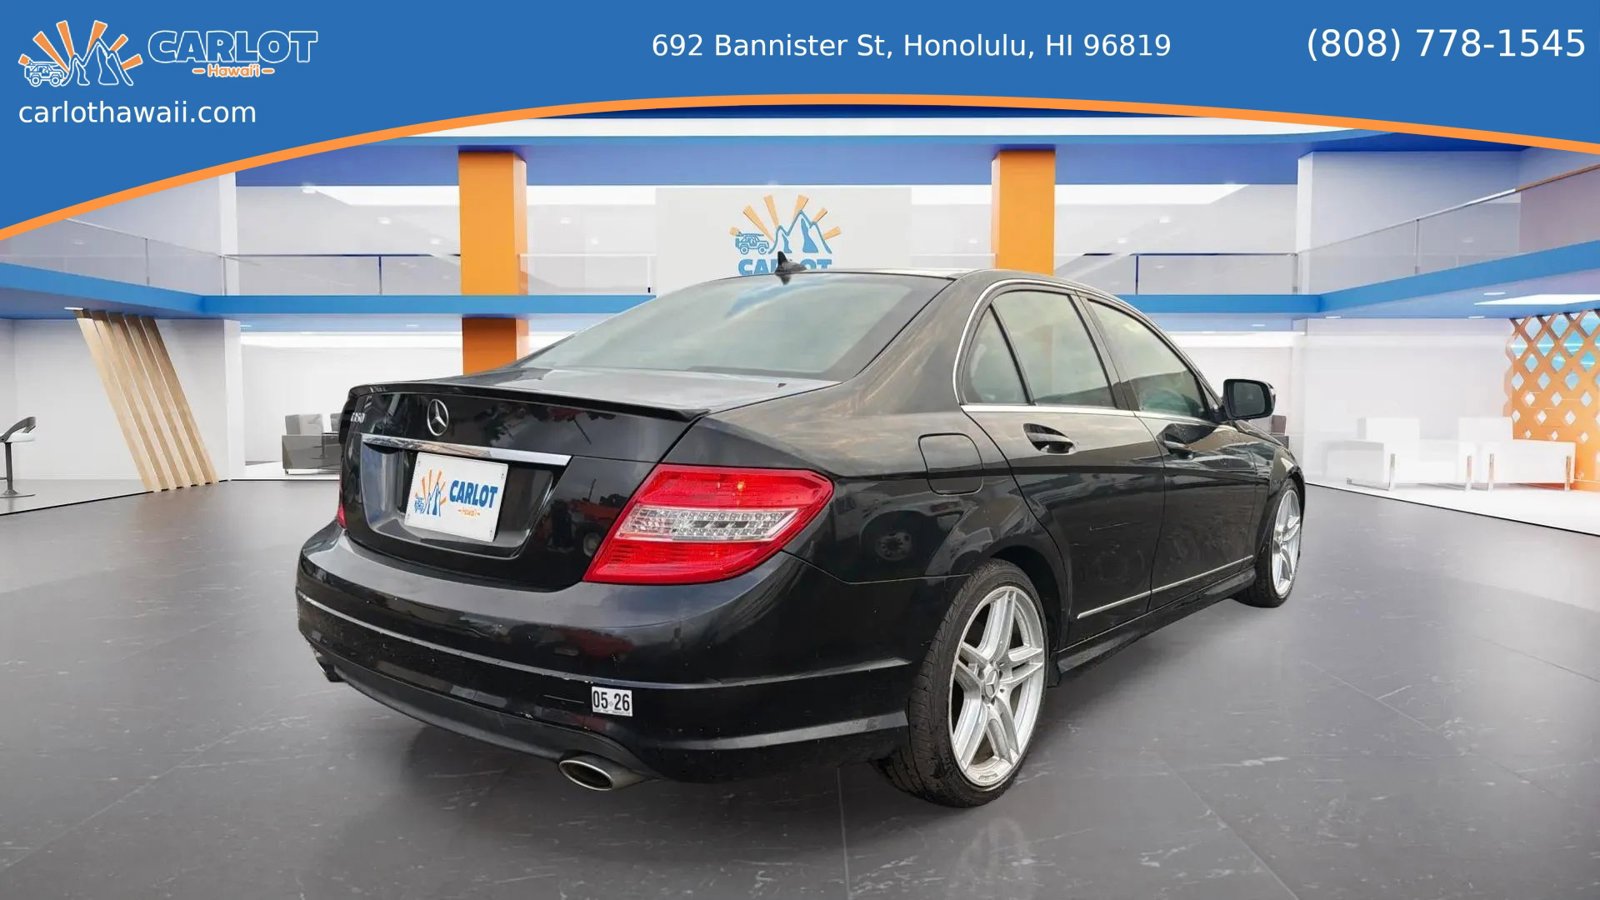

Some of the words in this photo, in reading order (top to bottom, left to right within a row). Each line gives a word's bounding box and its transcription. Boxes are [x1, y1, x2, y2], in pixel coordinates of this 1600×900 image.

[449, 480, 498, 508] CARLOT
[593, 690, 608, 709] 05
[613, 693, 630, 711] 26
